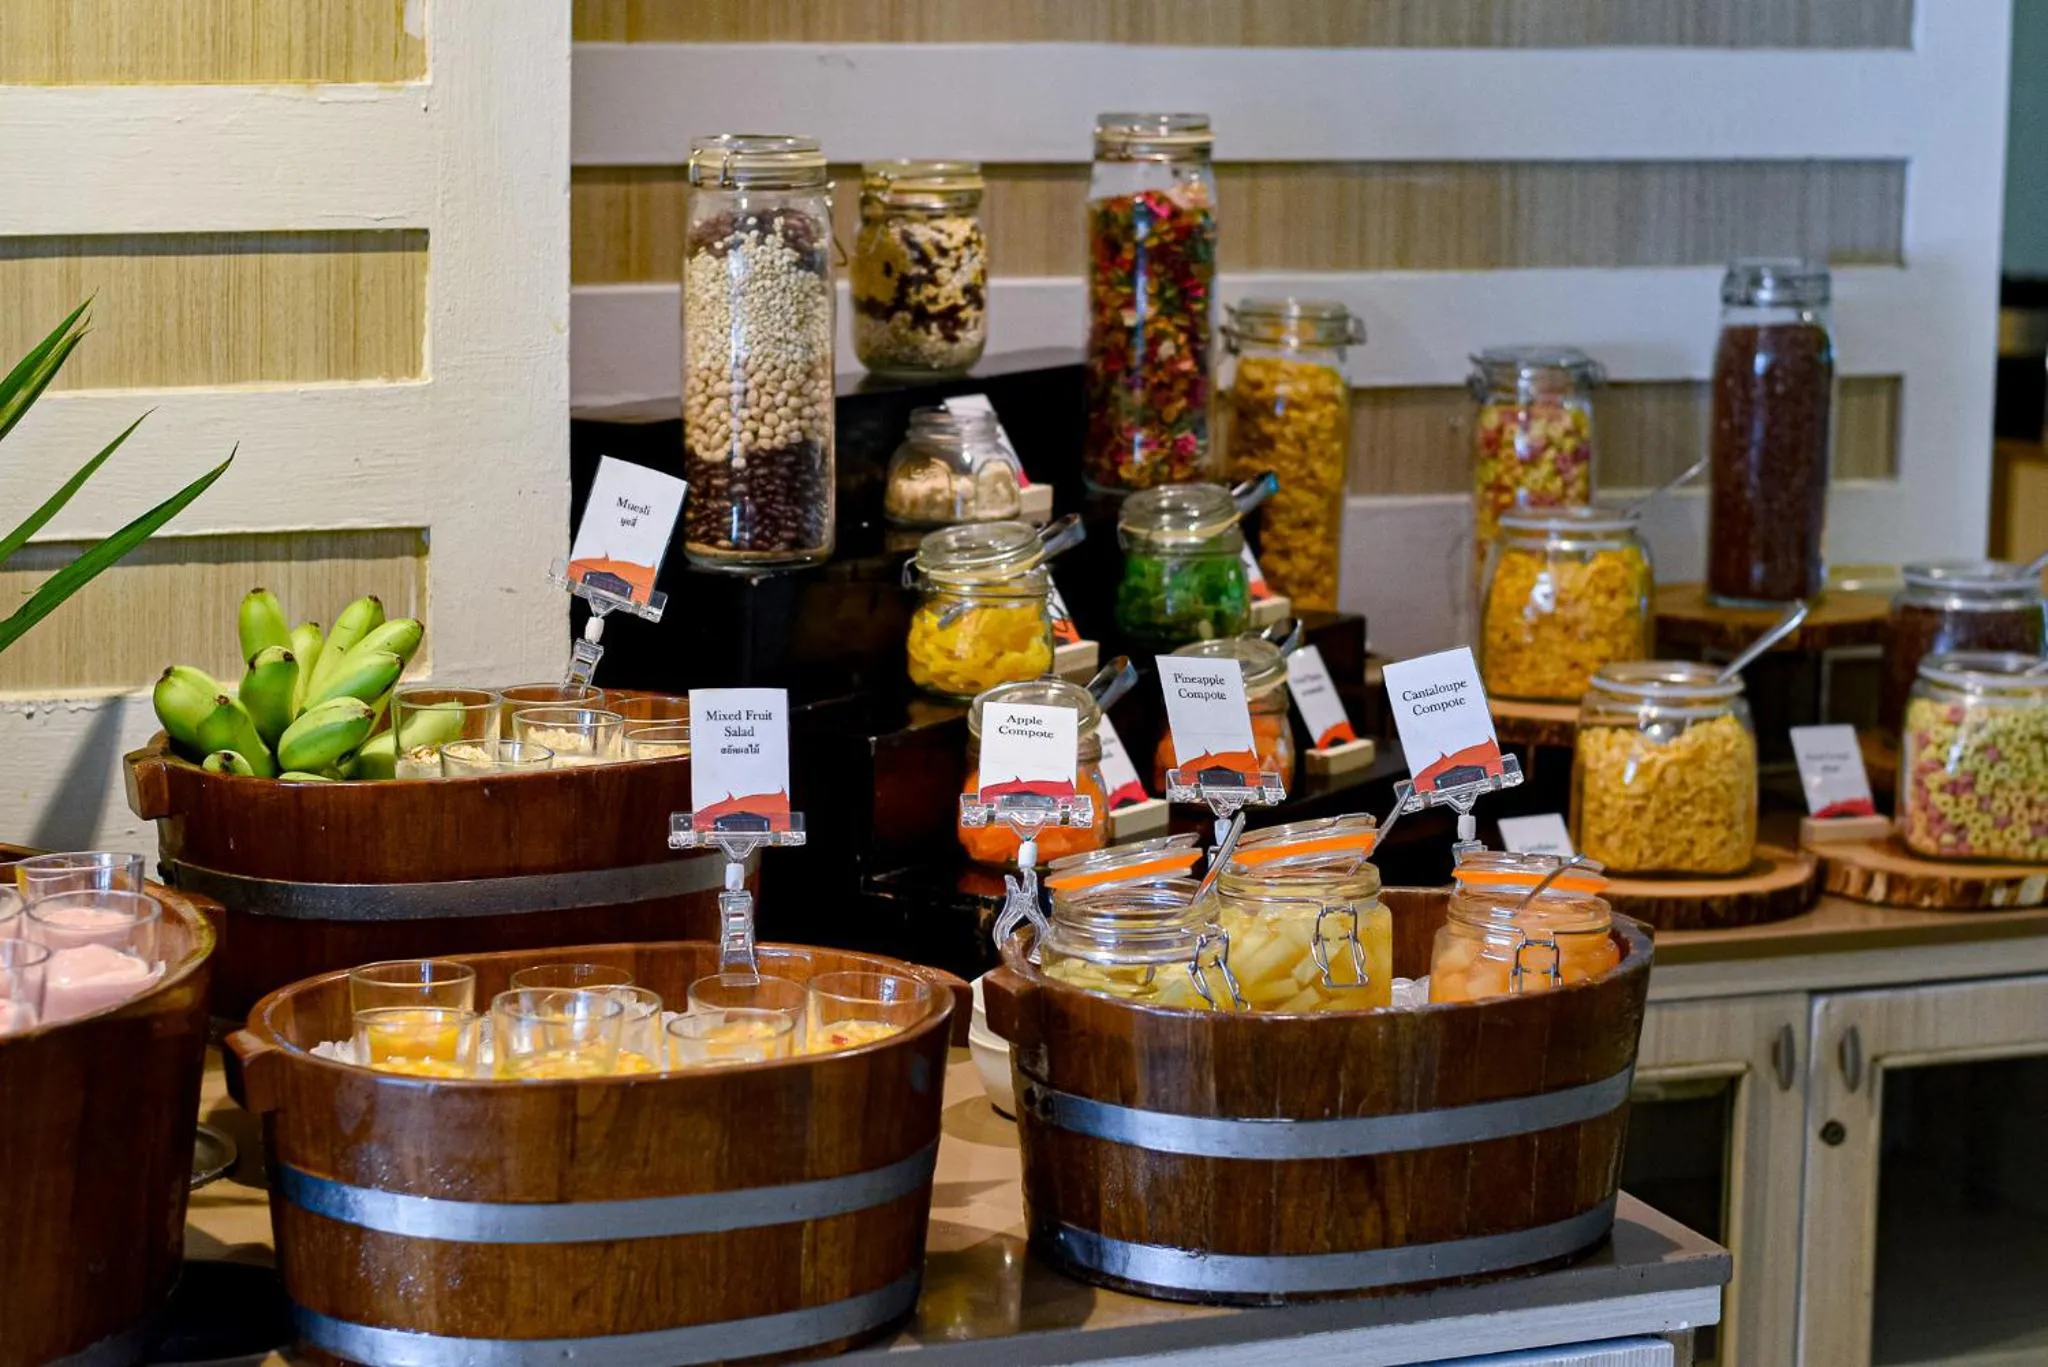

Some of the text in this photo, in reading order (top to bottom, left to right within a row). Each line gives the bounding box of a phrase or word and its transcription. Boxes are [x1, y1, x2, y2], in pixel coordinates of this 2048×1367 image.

[616, 496, 651, 516] Muesli
[1173, 672, 1225, 687] Pineapple
[1178, 687, 1227, 702] Compote
[1402, 680, 1467, 702] Cantaloupe
[1412, 697, 1466, 716] Compote
[706, 709, 773, 721] Mixed Fruit
[1007, 714, 1043, 726] Apple
[724, 725, 755, 737] Salad
[998, 725, 1055, 739] Compote
